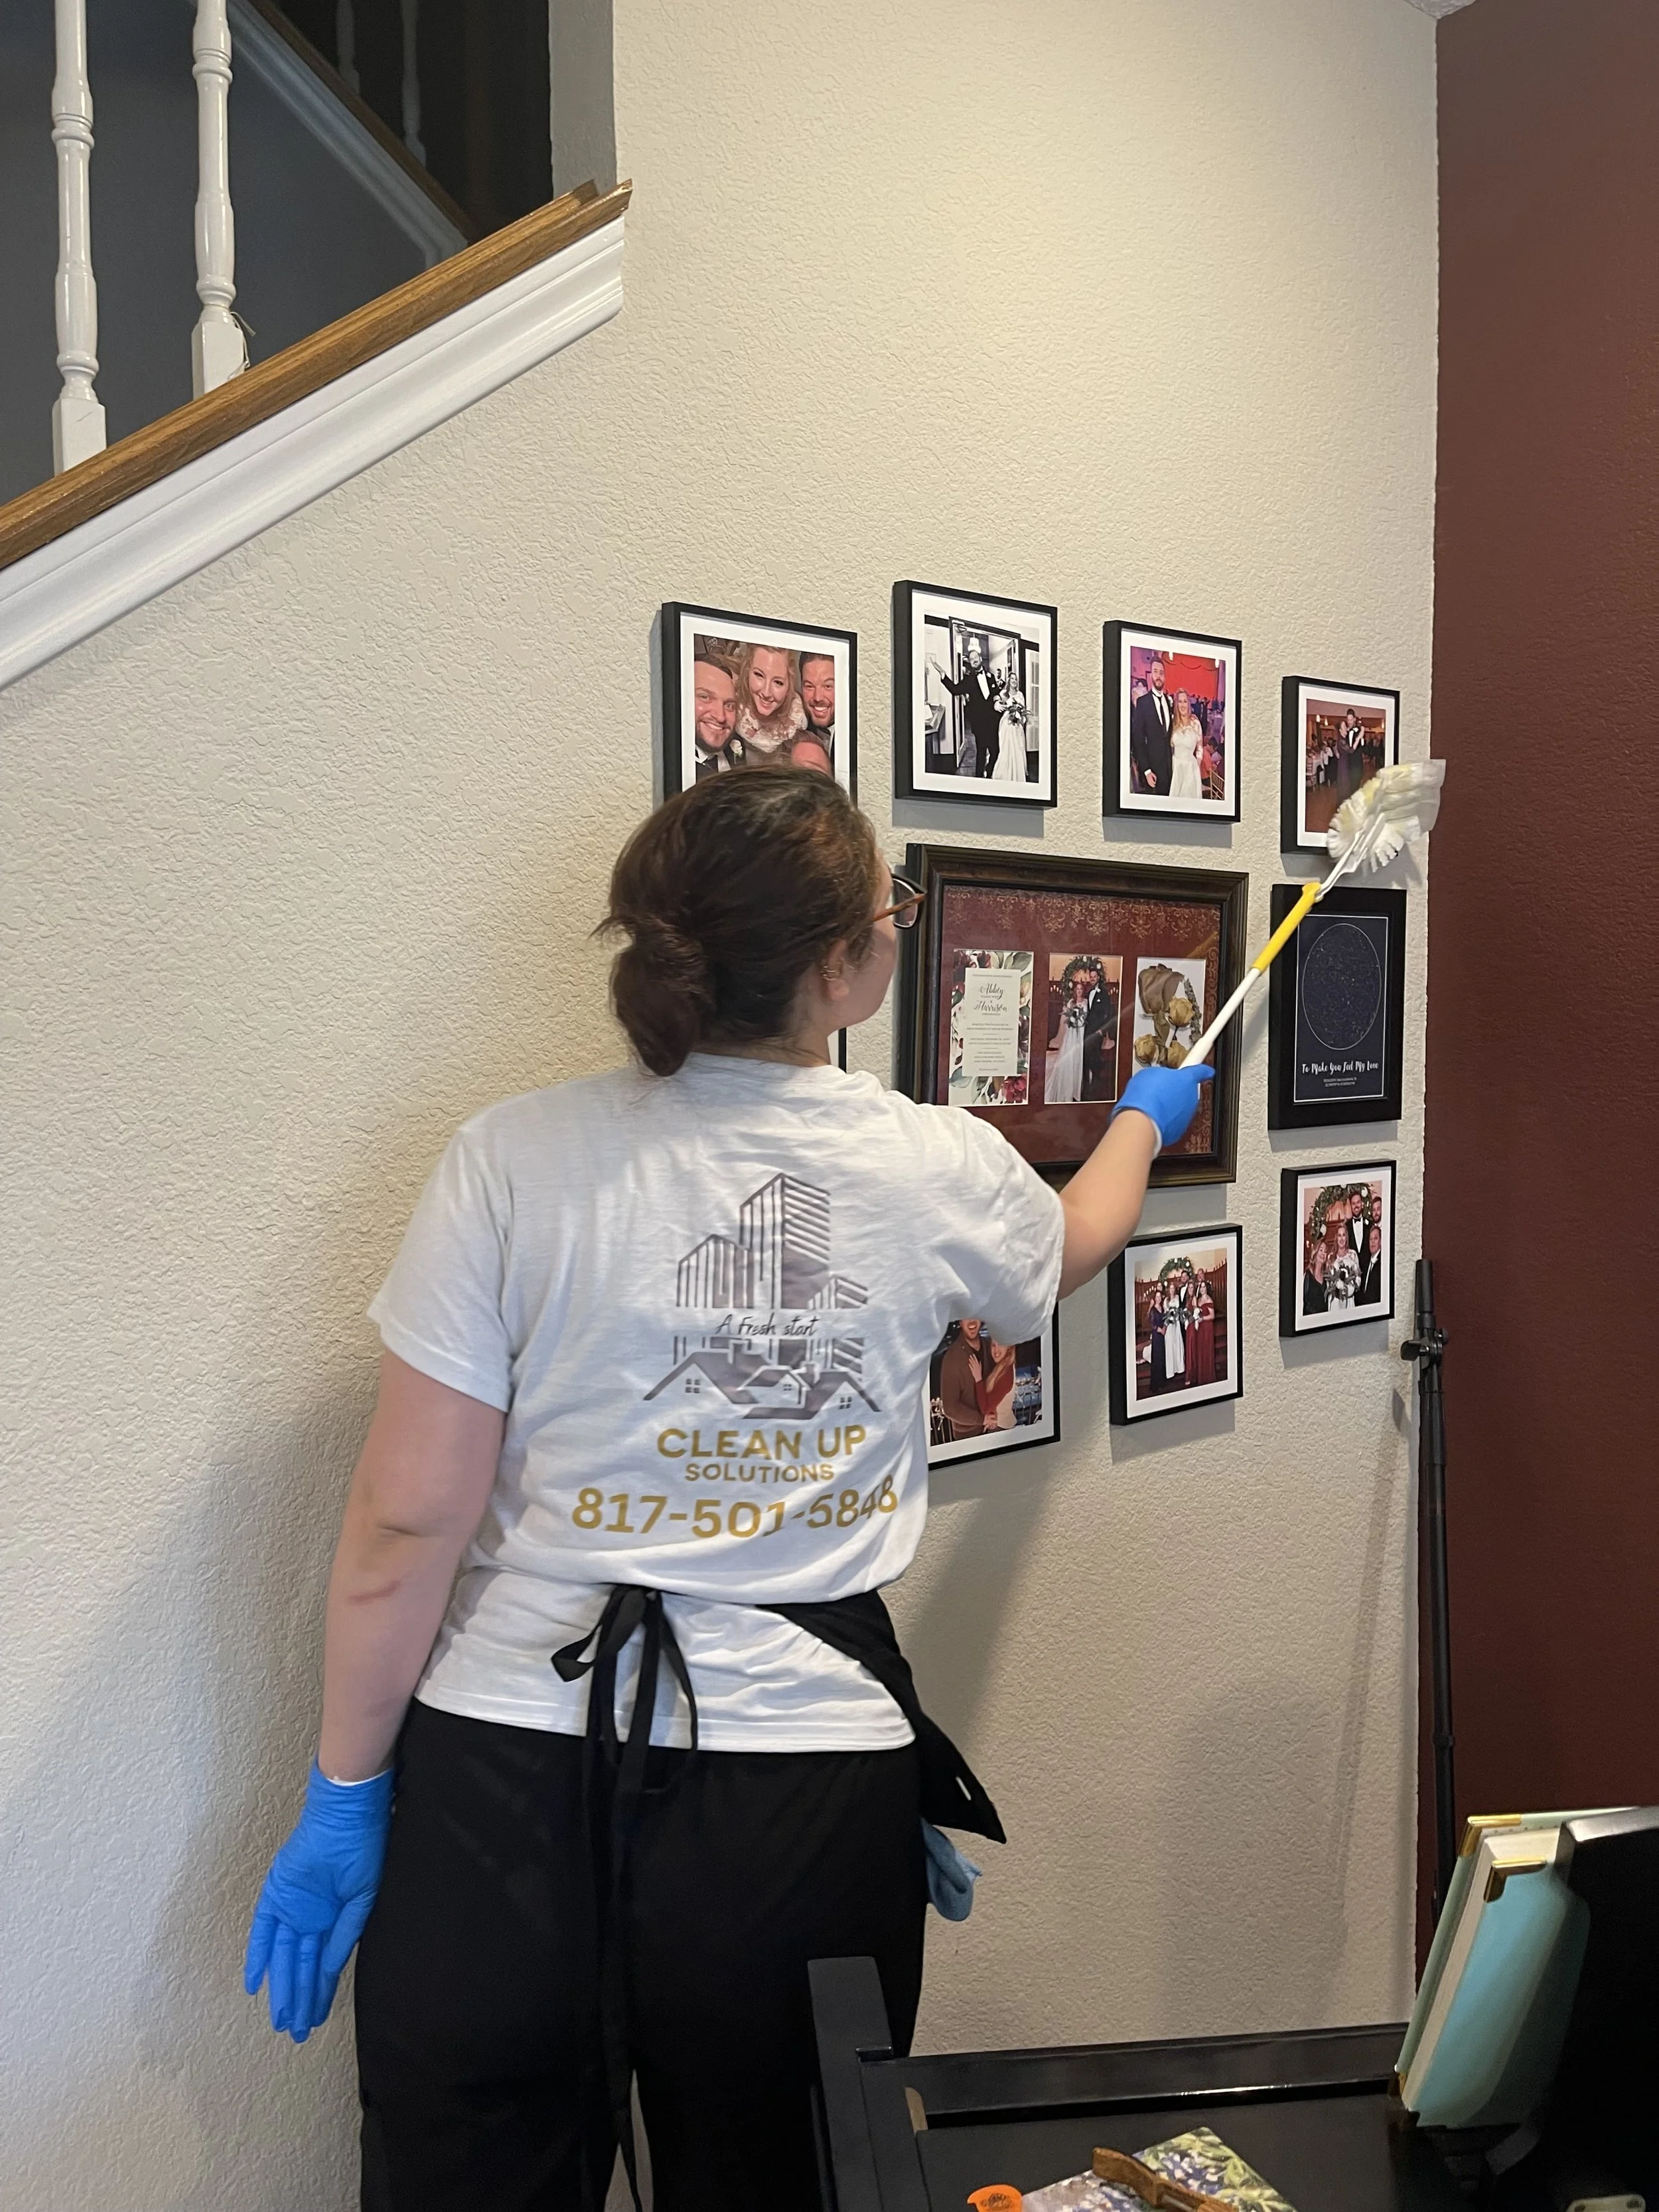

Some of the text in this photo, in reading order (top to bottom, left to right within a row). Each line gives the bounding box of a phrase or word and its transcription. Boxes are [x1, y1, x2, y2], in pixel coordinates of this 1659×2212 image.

[1302, 1061, 1378, 1075] To Make You Feel My Love
[715, 1311, 820, 1336] A Fresh start
[656, 1424, 867, 1460] CLEAN UP
[684, 1462, 835, 1483] SOLUTIONS
[571, 1474, 899, 1538] 817-501-5848
